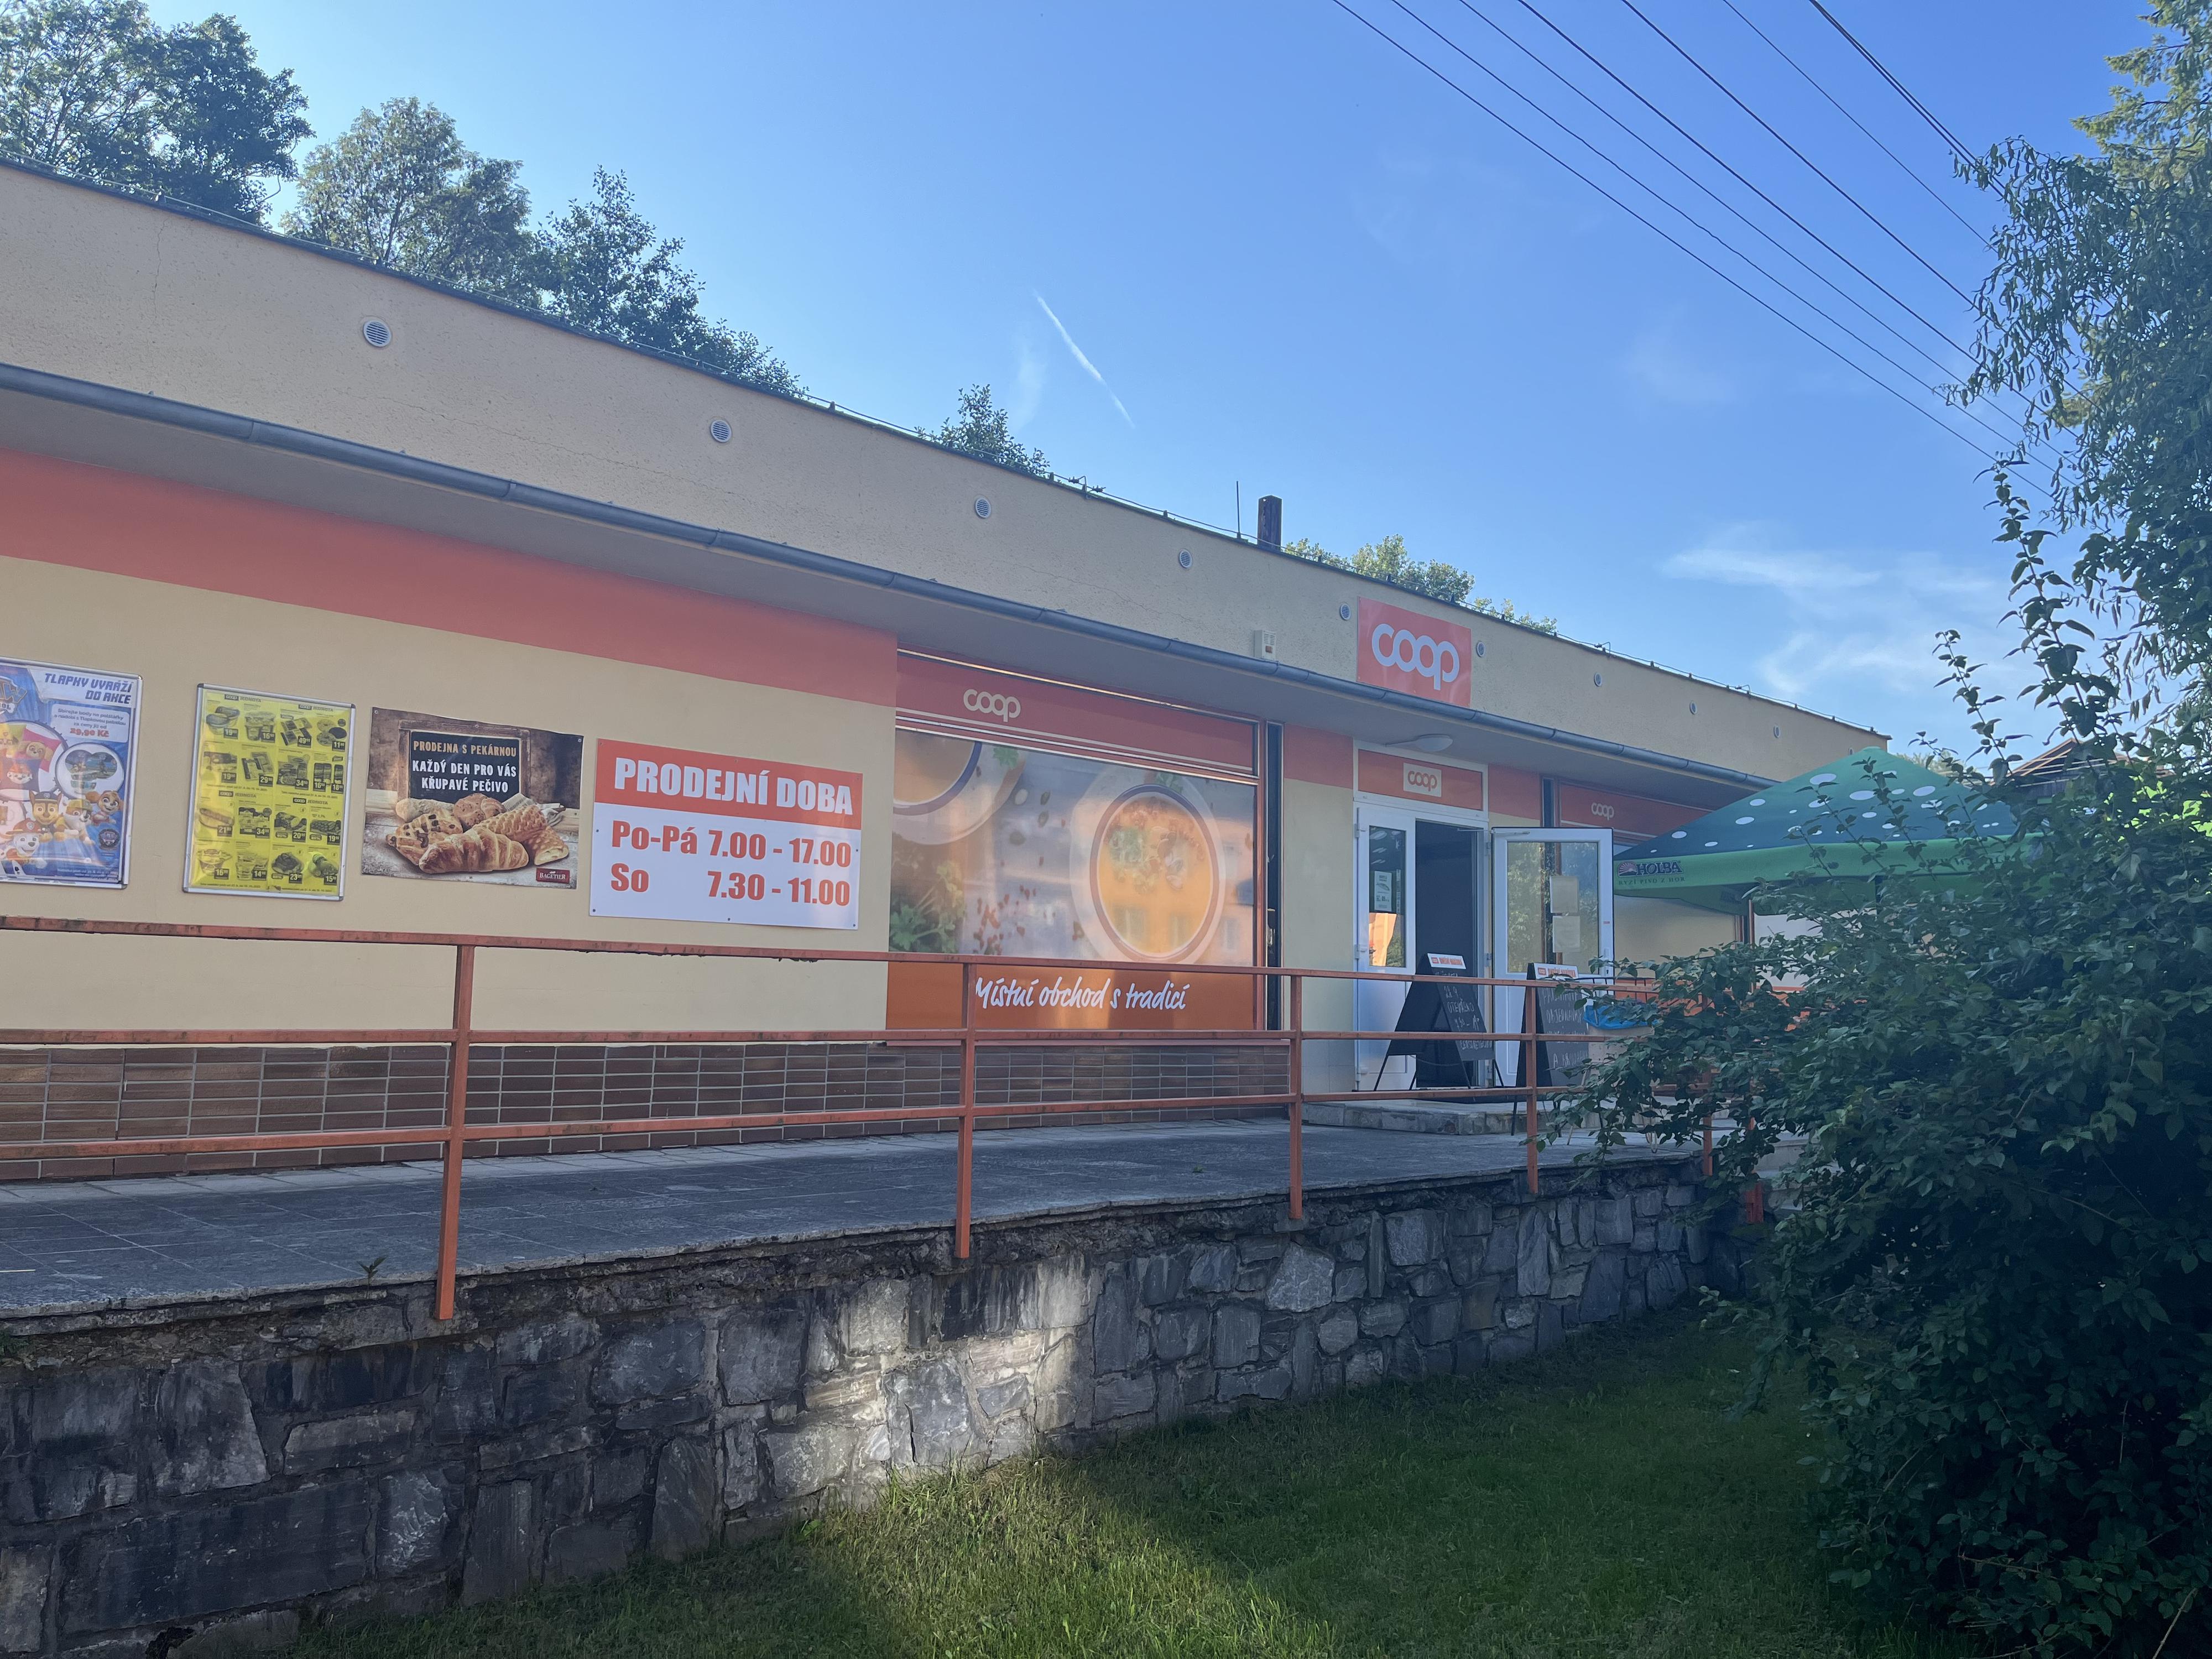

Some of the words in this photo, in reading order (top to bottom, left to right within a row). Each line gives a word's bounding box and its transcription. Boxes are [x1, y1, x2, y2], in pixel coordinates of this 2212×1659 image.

[45, 673, 88, 687] TLAPKY
[85, 690, 101, 700] DO
[102, 692, 132, 705] AKCE
[413, 740, 458, 754] PRODEJNA
[462, 744, 467, 754] S
[471, 739, 517, 757] PEKÁRNOU
[412, 759, 447, 774] KAŽDÝ
[451, 763, 470, 775] DEN
[474, 765, 494, 776] PRO
[497, 763, 517, 778] VÁS
[421, 776, 468, 791] KŘUPAVÉ
[473, 779, 509, 793] PEČIVO
[614, 757, 770, 805] PRODEJNÍ
[776, 777, 853, 815] DOBA
[612, 820, 698, 854] Po-Pá
[708, 829, 766, 860] 7.00
[789, 837, 852, 868] 17.00
[1636, 861, 1683, 875] HOLBA
[611, 863, 650, 893] So
[707, 870, 765, 901] 7.30
[787, 877, 851, 907] 11.00
[1039, 976, 1111, 1009] obchod
[1110, 987, 1121, 1009] s
[1125, 980, 1190, 1010] tradicí
